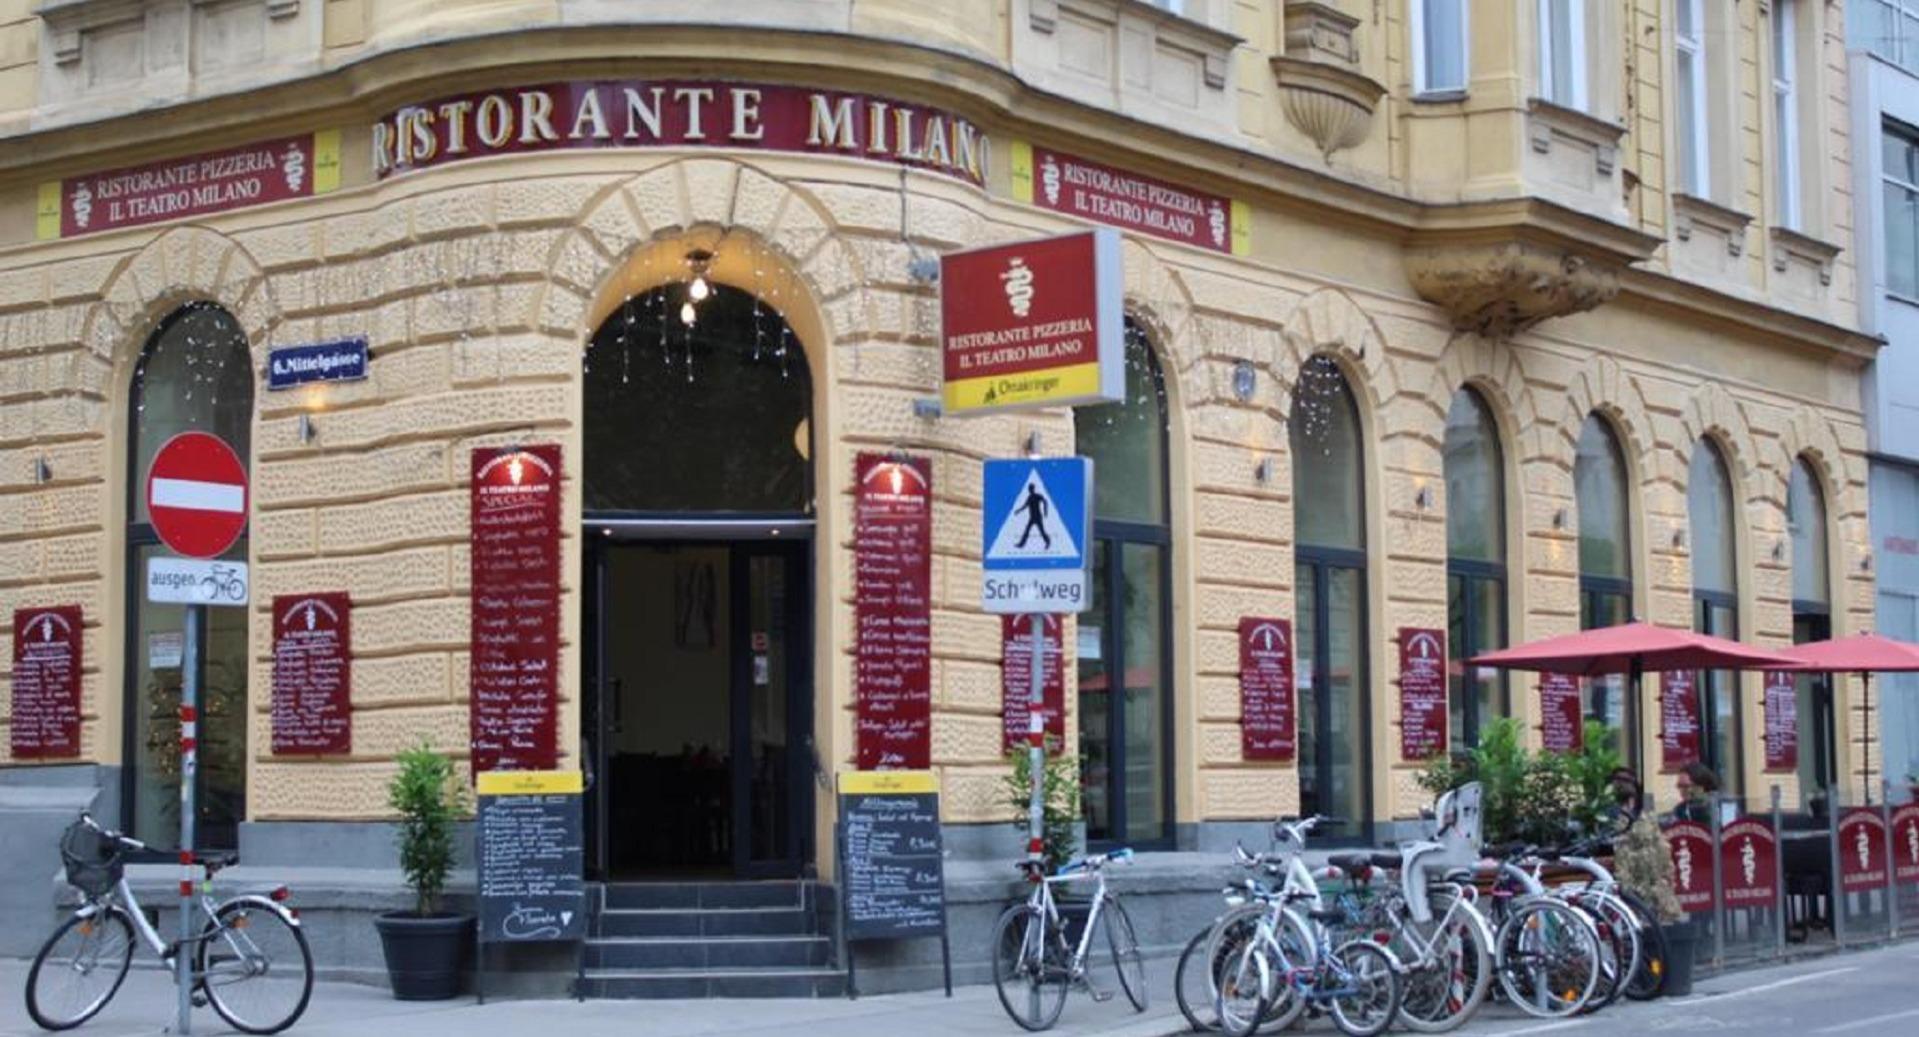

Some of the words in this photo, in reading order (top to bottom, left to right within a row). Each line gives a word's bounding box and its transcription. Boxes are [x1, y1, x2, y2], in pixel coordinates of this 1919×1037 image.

[372, 87, 763, 172] RISTORANTE
[806, 94, 991, 181] MILANO
[97, 164, 197, 200] RISTORANTE
[200, 150, 276, 180] PIZZERIA
[1063, 163, 1148, 200] RISTORANTE
[1148, 184, 1205, 216] PIZZERIA
[109, 201, 124, 222] IL
[127, 191, 190, 218] TEATRO
[192, 178, 262, 206] MILANO
[1074, 190, 1089, 211] IL
[1089, 192, 1142, 223] TEATRO
[1143, 208, 1195, 237] MILANO
[948, 326, 1030, 351] RISTORANTE
[1032, 317, 1093, 339] PIZZERIA
[959, 354, 973, 369] IL
[975, 348, 1027, 367] TEATRO
[1028, 339, 1083, 360] MILANO
